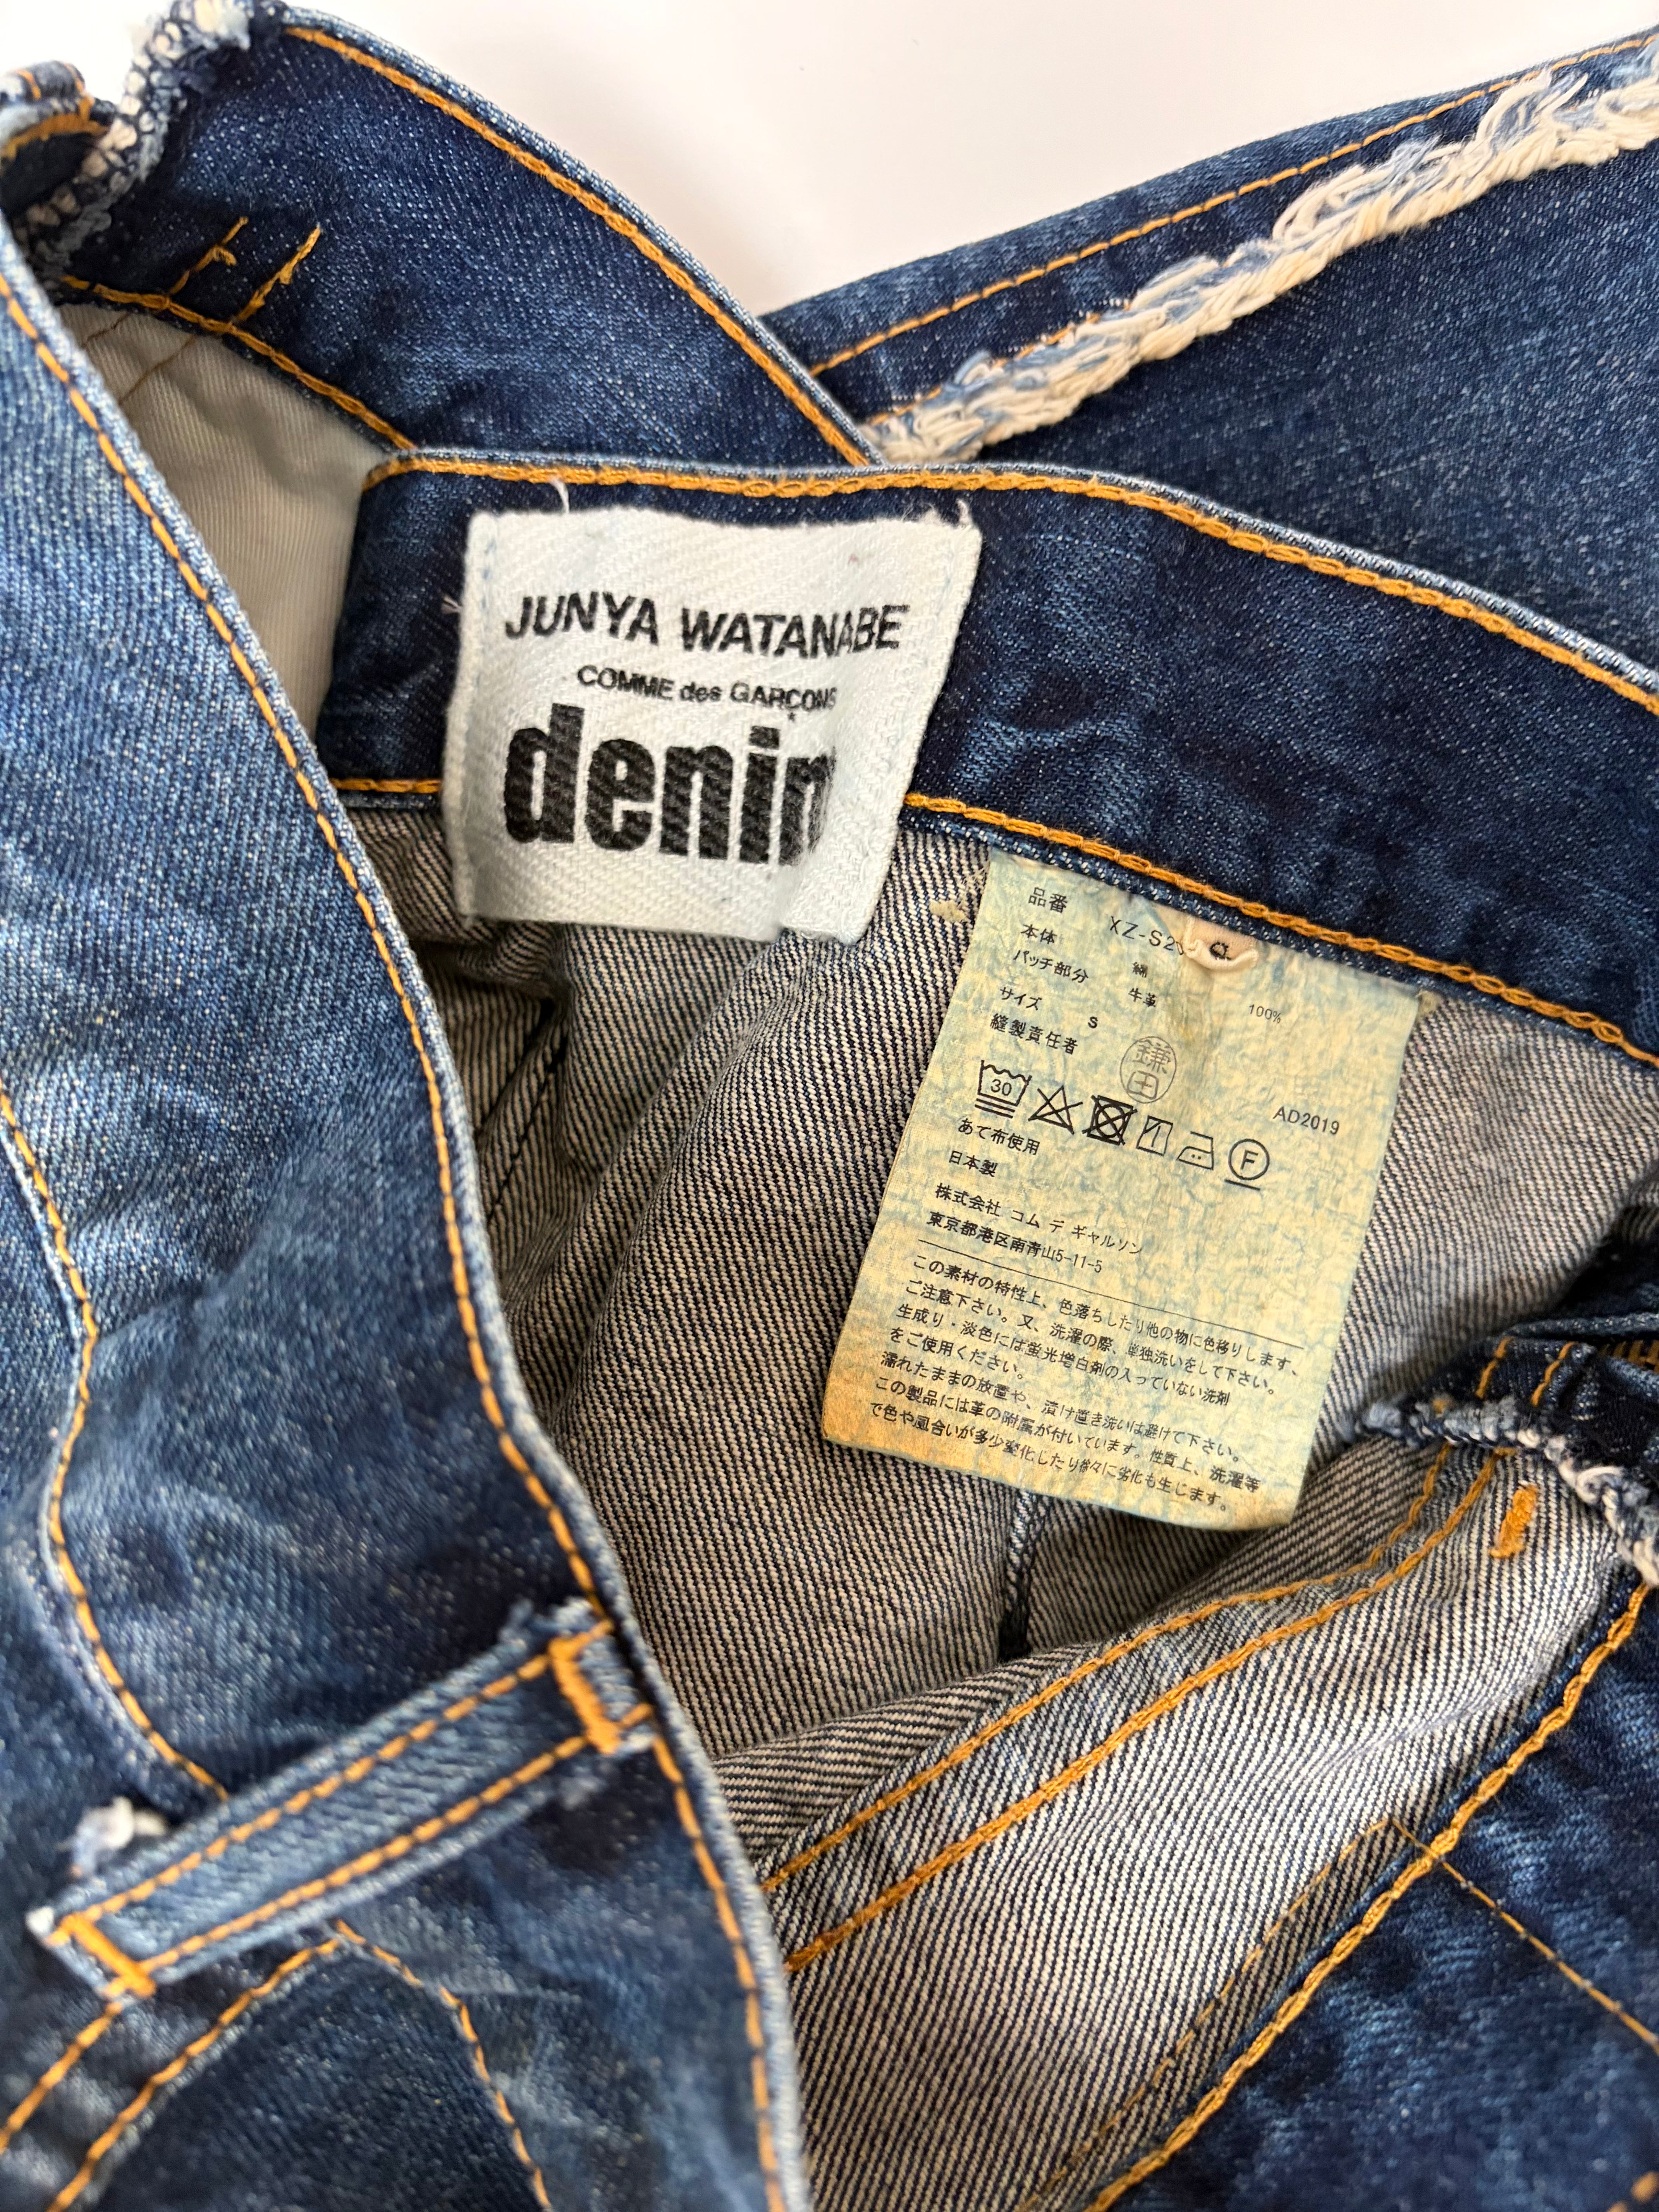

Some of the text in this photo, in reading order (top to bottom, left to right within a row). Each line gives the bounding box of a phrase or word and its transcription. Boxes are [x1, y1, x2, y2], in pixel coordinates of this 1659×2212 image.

[505, 592, 910, 658] JUNYA WATANABE
[577, 665, 674, 700] COMME
[680, 682, 722, 702] des
[1028, 887, 1068, 913] 品番
[1021, 924, 1057, 944] 本体
[1014, 950, 1088, 983] パッチ部分
[1000, 987, 1042, 1010] サイズ
[1128, 988, 1157, 1007] 牛革
[1087, 1016, 1098, 1028] S
[1249, 1004, 1281, 1024] 100%
[990, 1013, 1078, 1055] 縫製責任者
[991, 1079, 1012, 1096] 30
[1272, 1106, 1340, 1135] AD2019
[956, 1117, 1040, 1155] あて布使用
[949, 1151, 998, 1177] 日本製
[1241, 1150, 1258, 1169] F
[935, 1183, 1142, 1254] 株式会社 コム デ ギャルソン
[927, 1211, 1102, 1273] 東京都港区南青山5-11-5
[891, 1327, 1023, 1379] をご使用ください。
